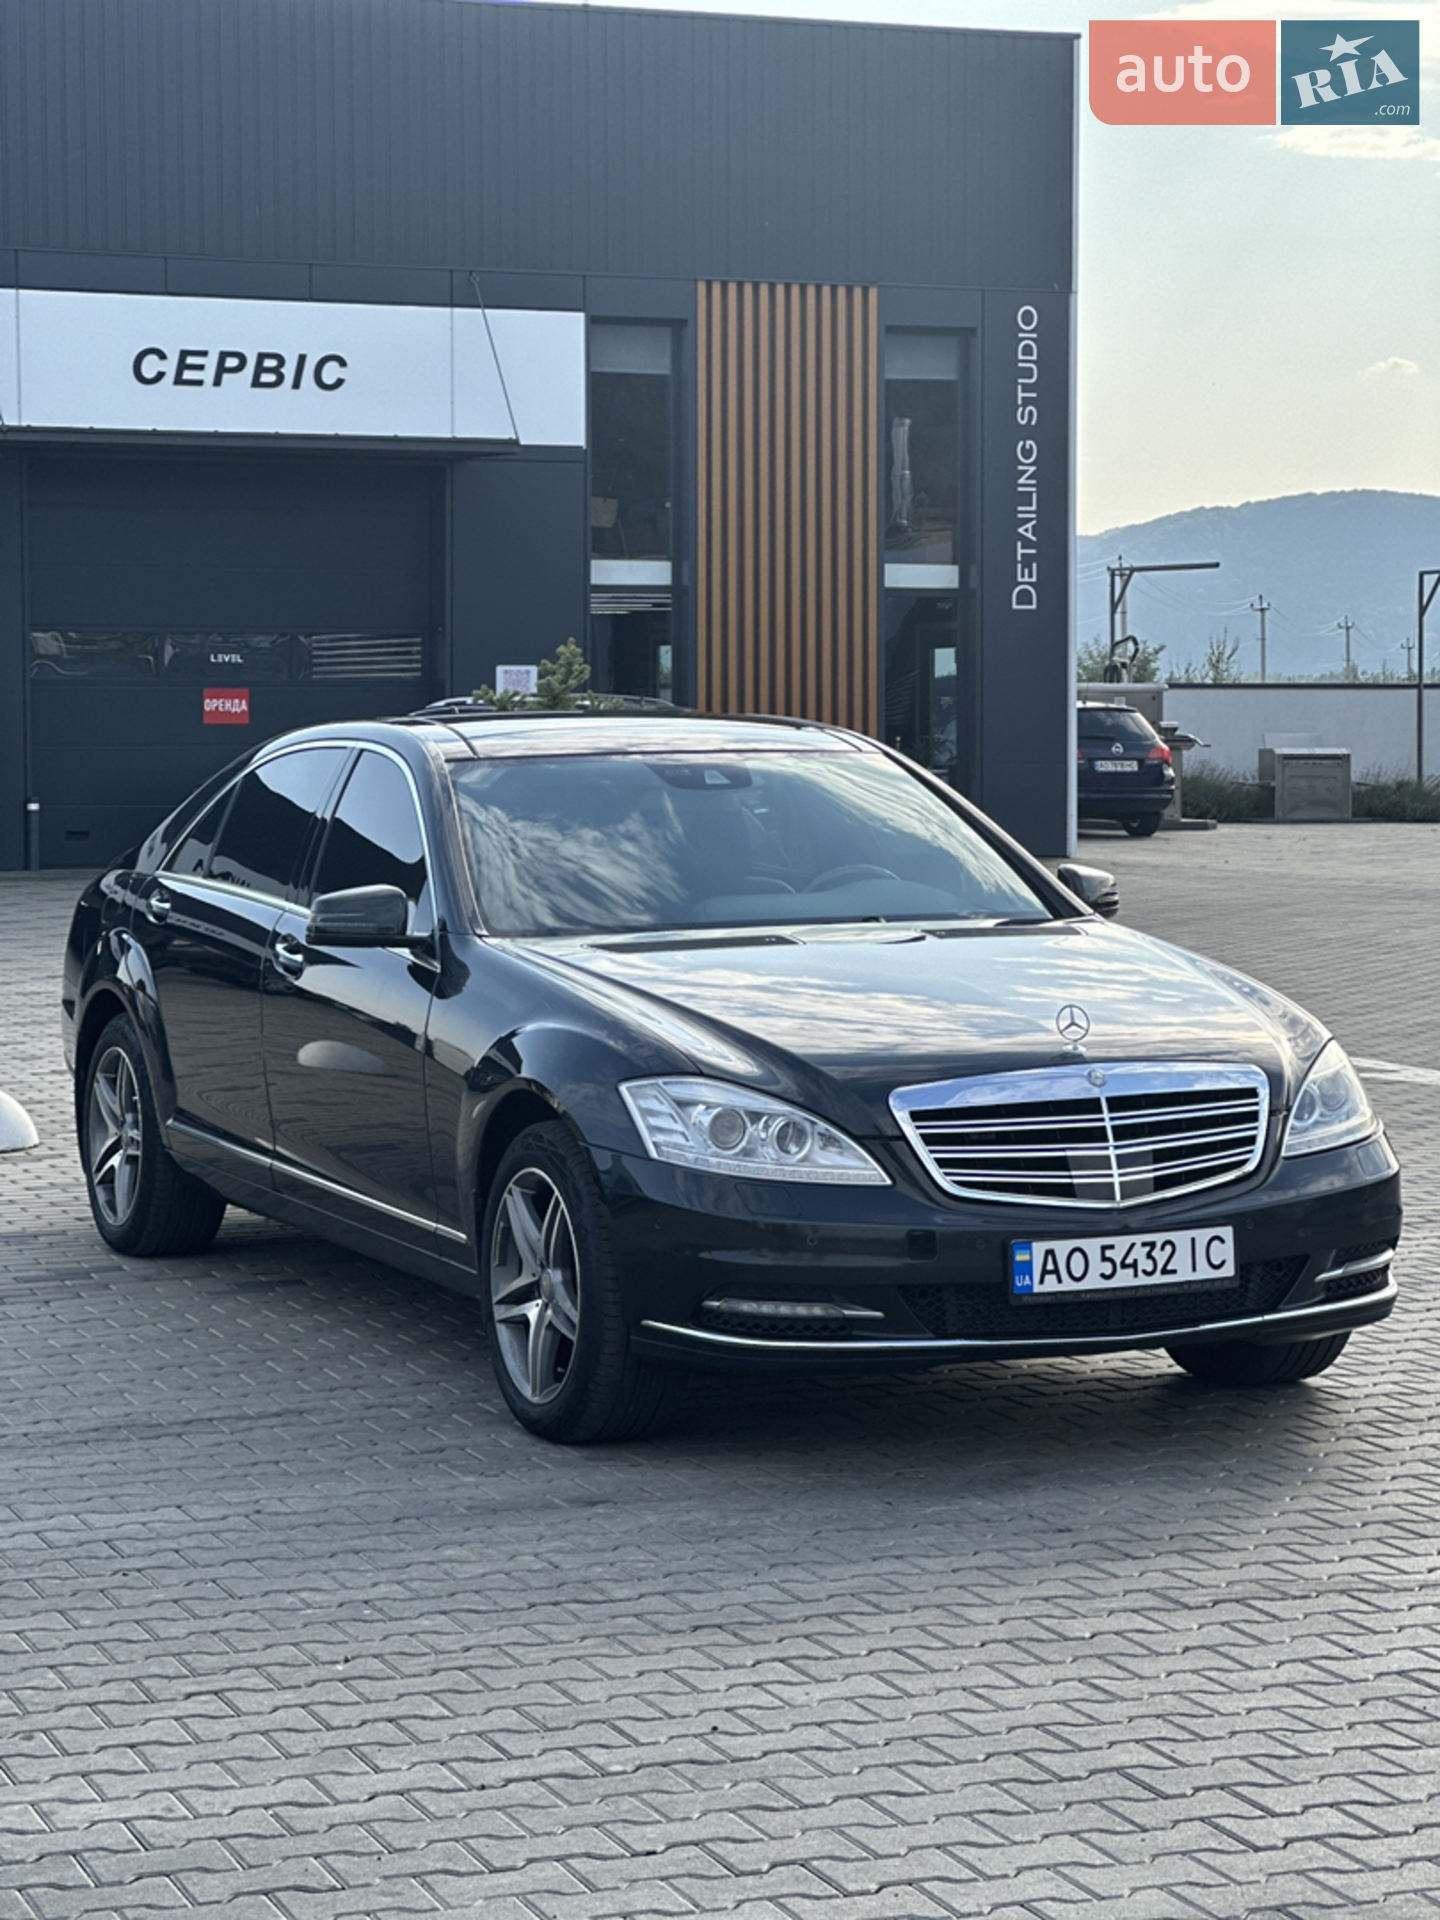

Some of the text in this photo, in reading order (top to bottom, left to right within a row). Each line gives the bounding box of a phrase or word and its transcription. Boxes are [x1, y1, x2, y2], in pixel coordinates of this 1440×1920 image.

[132, 346, 349, 392] СЕРВІС
[1011, 305, 1039, 610] DETAILING STUDIO
[209, 653, 244, 664] LEVEL
[204, 698, 248, 714] ОРЕНДА
[1038, 1235, 1227, 1285] AO 5432 IC
[1015, 1275, 1032, 1287] UA
